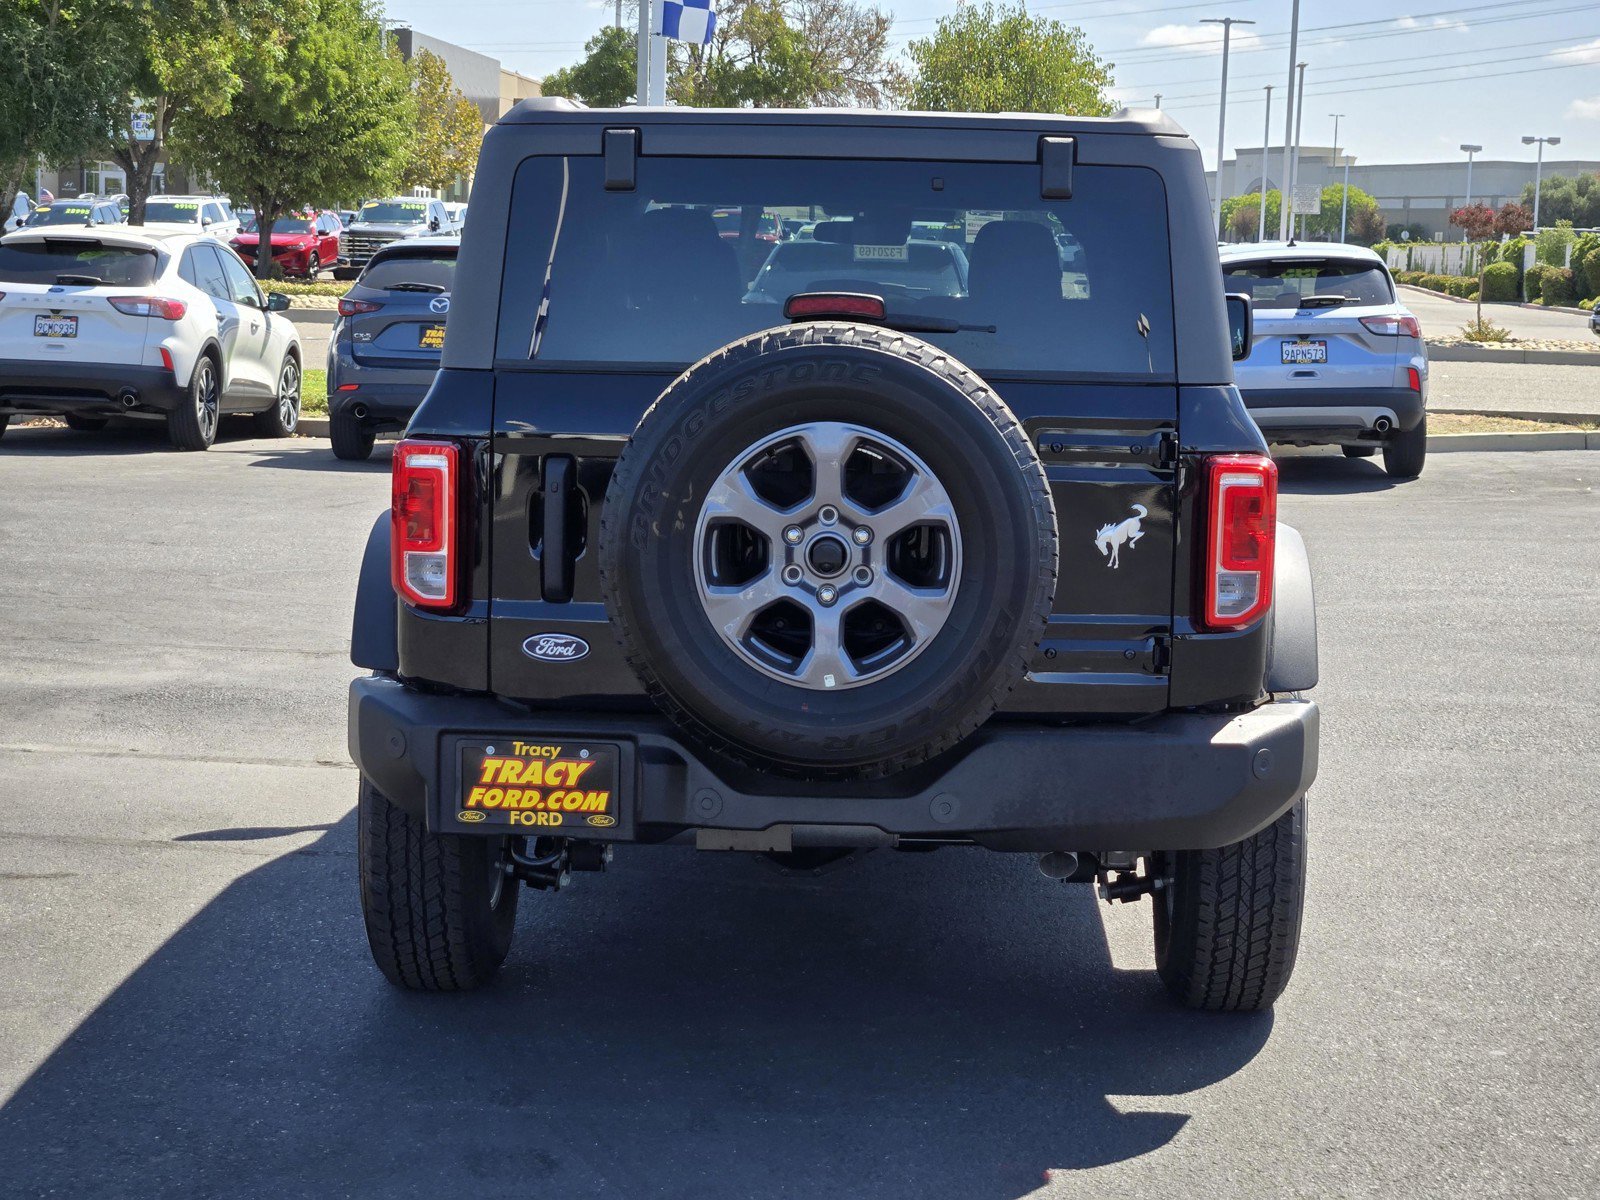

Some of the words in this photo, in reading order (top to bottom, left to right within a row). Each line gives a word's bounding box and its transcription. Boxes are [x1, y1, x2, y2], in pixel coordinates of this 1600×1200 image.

[37, 322, 75, 334] 9CMC935
[1284, 348, 1325, 360] 9APN573
[629, 360, 882, 554] BRIDGESTONE
[534, 637, 577, 656] Ford
[512, 741, 562, 760] Tracy
[480, 758, 593, 787] TRACY
[466, 787, 610, 811] FORD.COM
[510, 811, 563, 826] FORD
